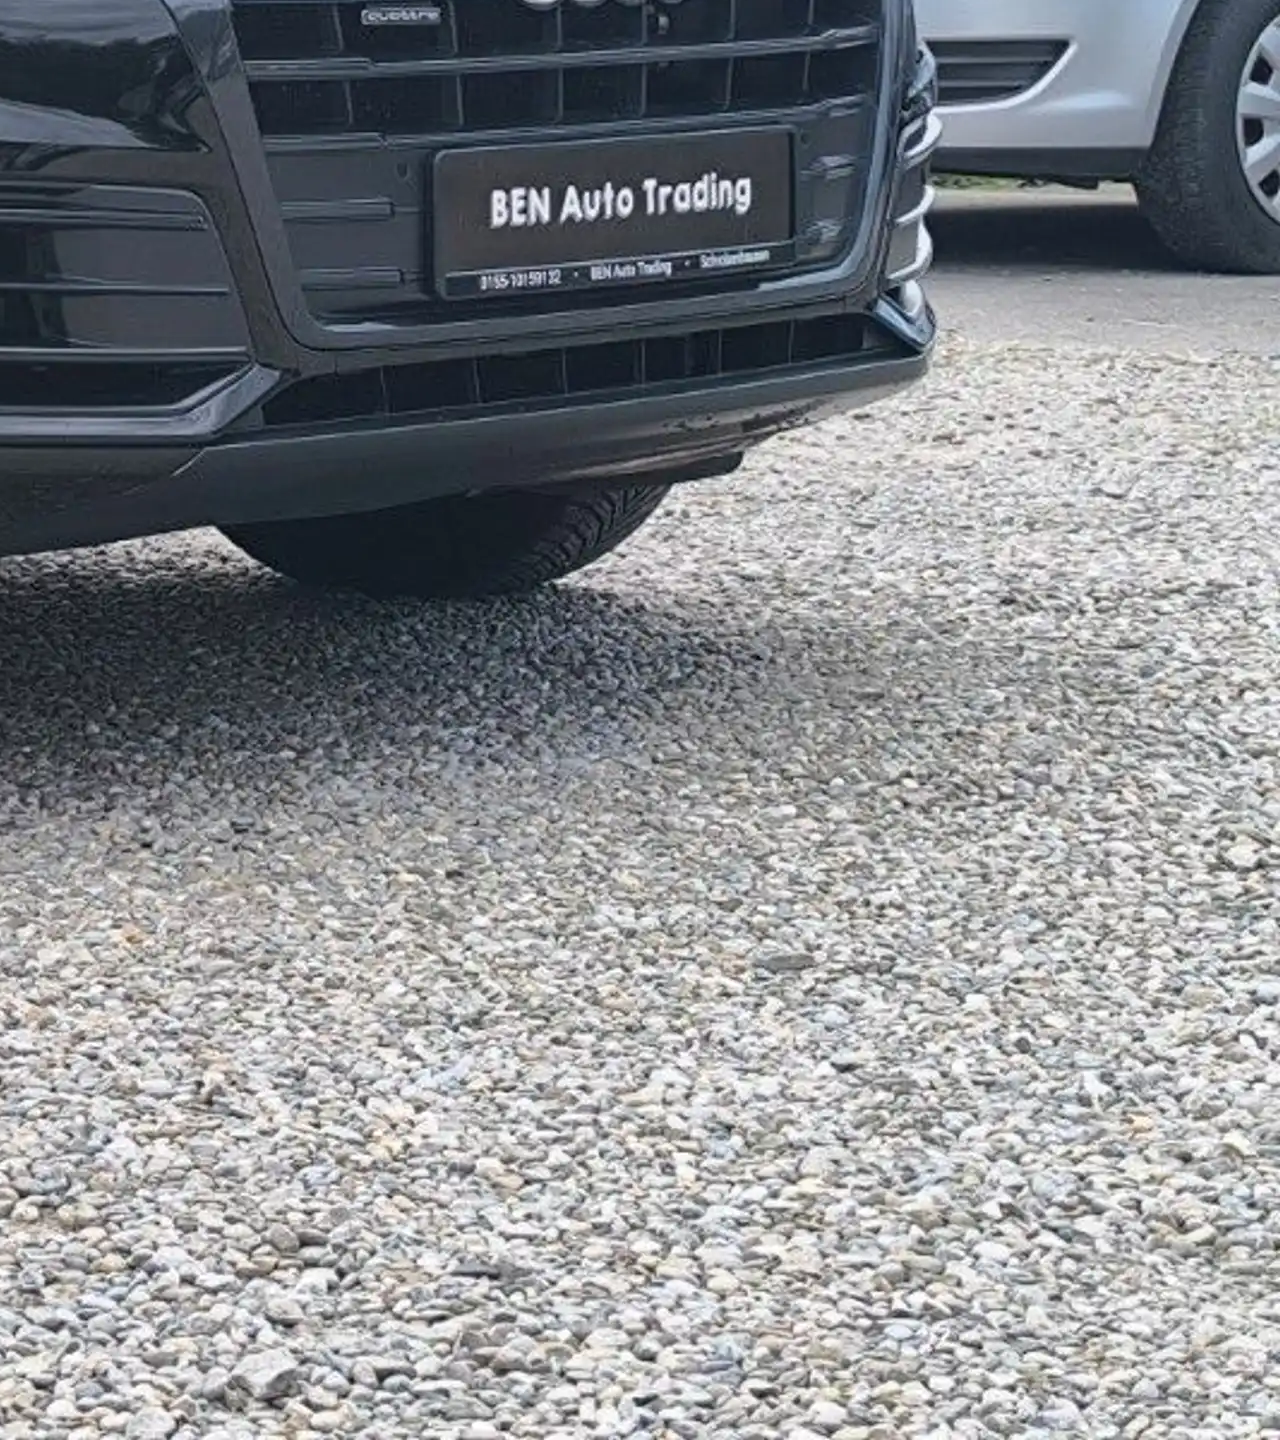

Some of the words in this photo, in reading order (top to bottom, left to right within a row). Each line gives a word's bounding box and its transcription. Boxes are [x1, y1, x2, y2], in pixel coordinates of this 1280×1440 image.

[368, 9, 439, 24] quattro
[490, 187, 550, 228] BEN
[559, 181, 635, 224] Auto
[643, 172, 752, 215] Trading
[591, 263, 612, 281] BEN
[613, 260, 636, 278] Auto
[637, 259, 672, 277] Trading
